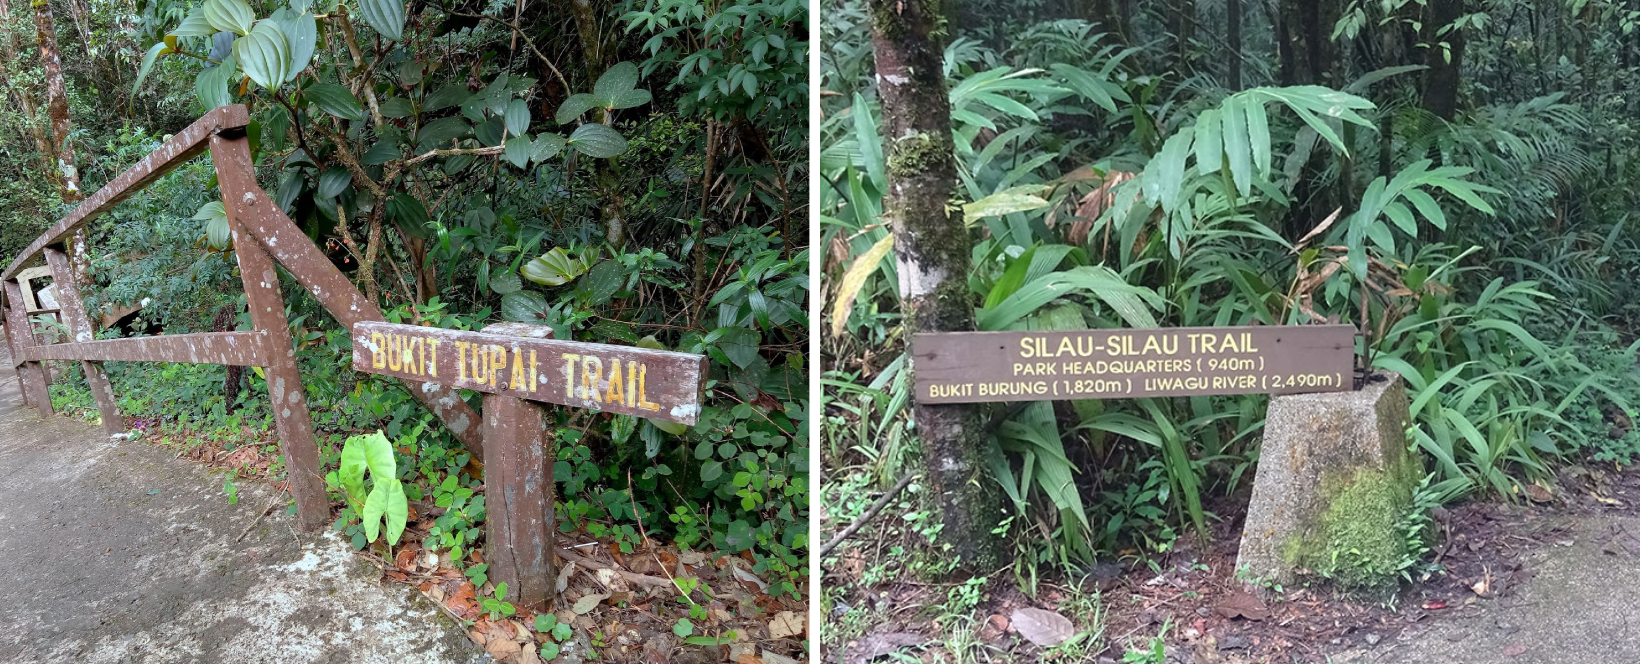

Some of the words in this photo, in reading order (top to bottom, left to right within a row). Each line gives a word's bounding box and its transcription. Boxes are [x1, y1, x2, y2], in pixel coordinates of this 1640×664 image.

[1019, 334, 1178, 358] SILAU-SILAU
[1187, 333, 1258, 354] TRAIL
[371, 332, 441, 378] BUKIT
[455, 341, 537, 393] TUPAI
[562, 353, 660, 411] TRAIL
[1013, 362, 1056, 376] PARK
[1062, 359, 1191, 375] HEADQUARTERS
[929, 383, 973, 398] BUKIT
[979, 381, 1048, 396] BURUNG
[1145, 376, 1208, 391] LIWAGU
[1213, 375, 1256, 389] RIVER
